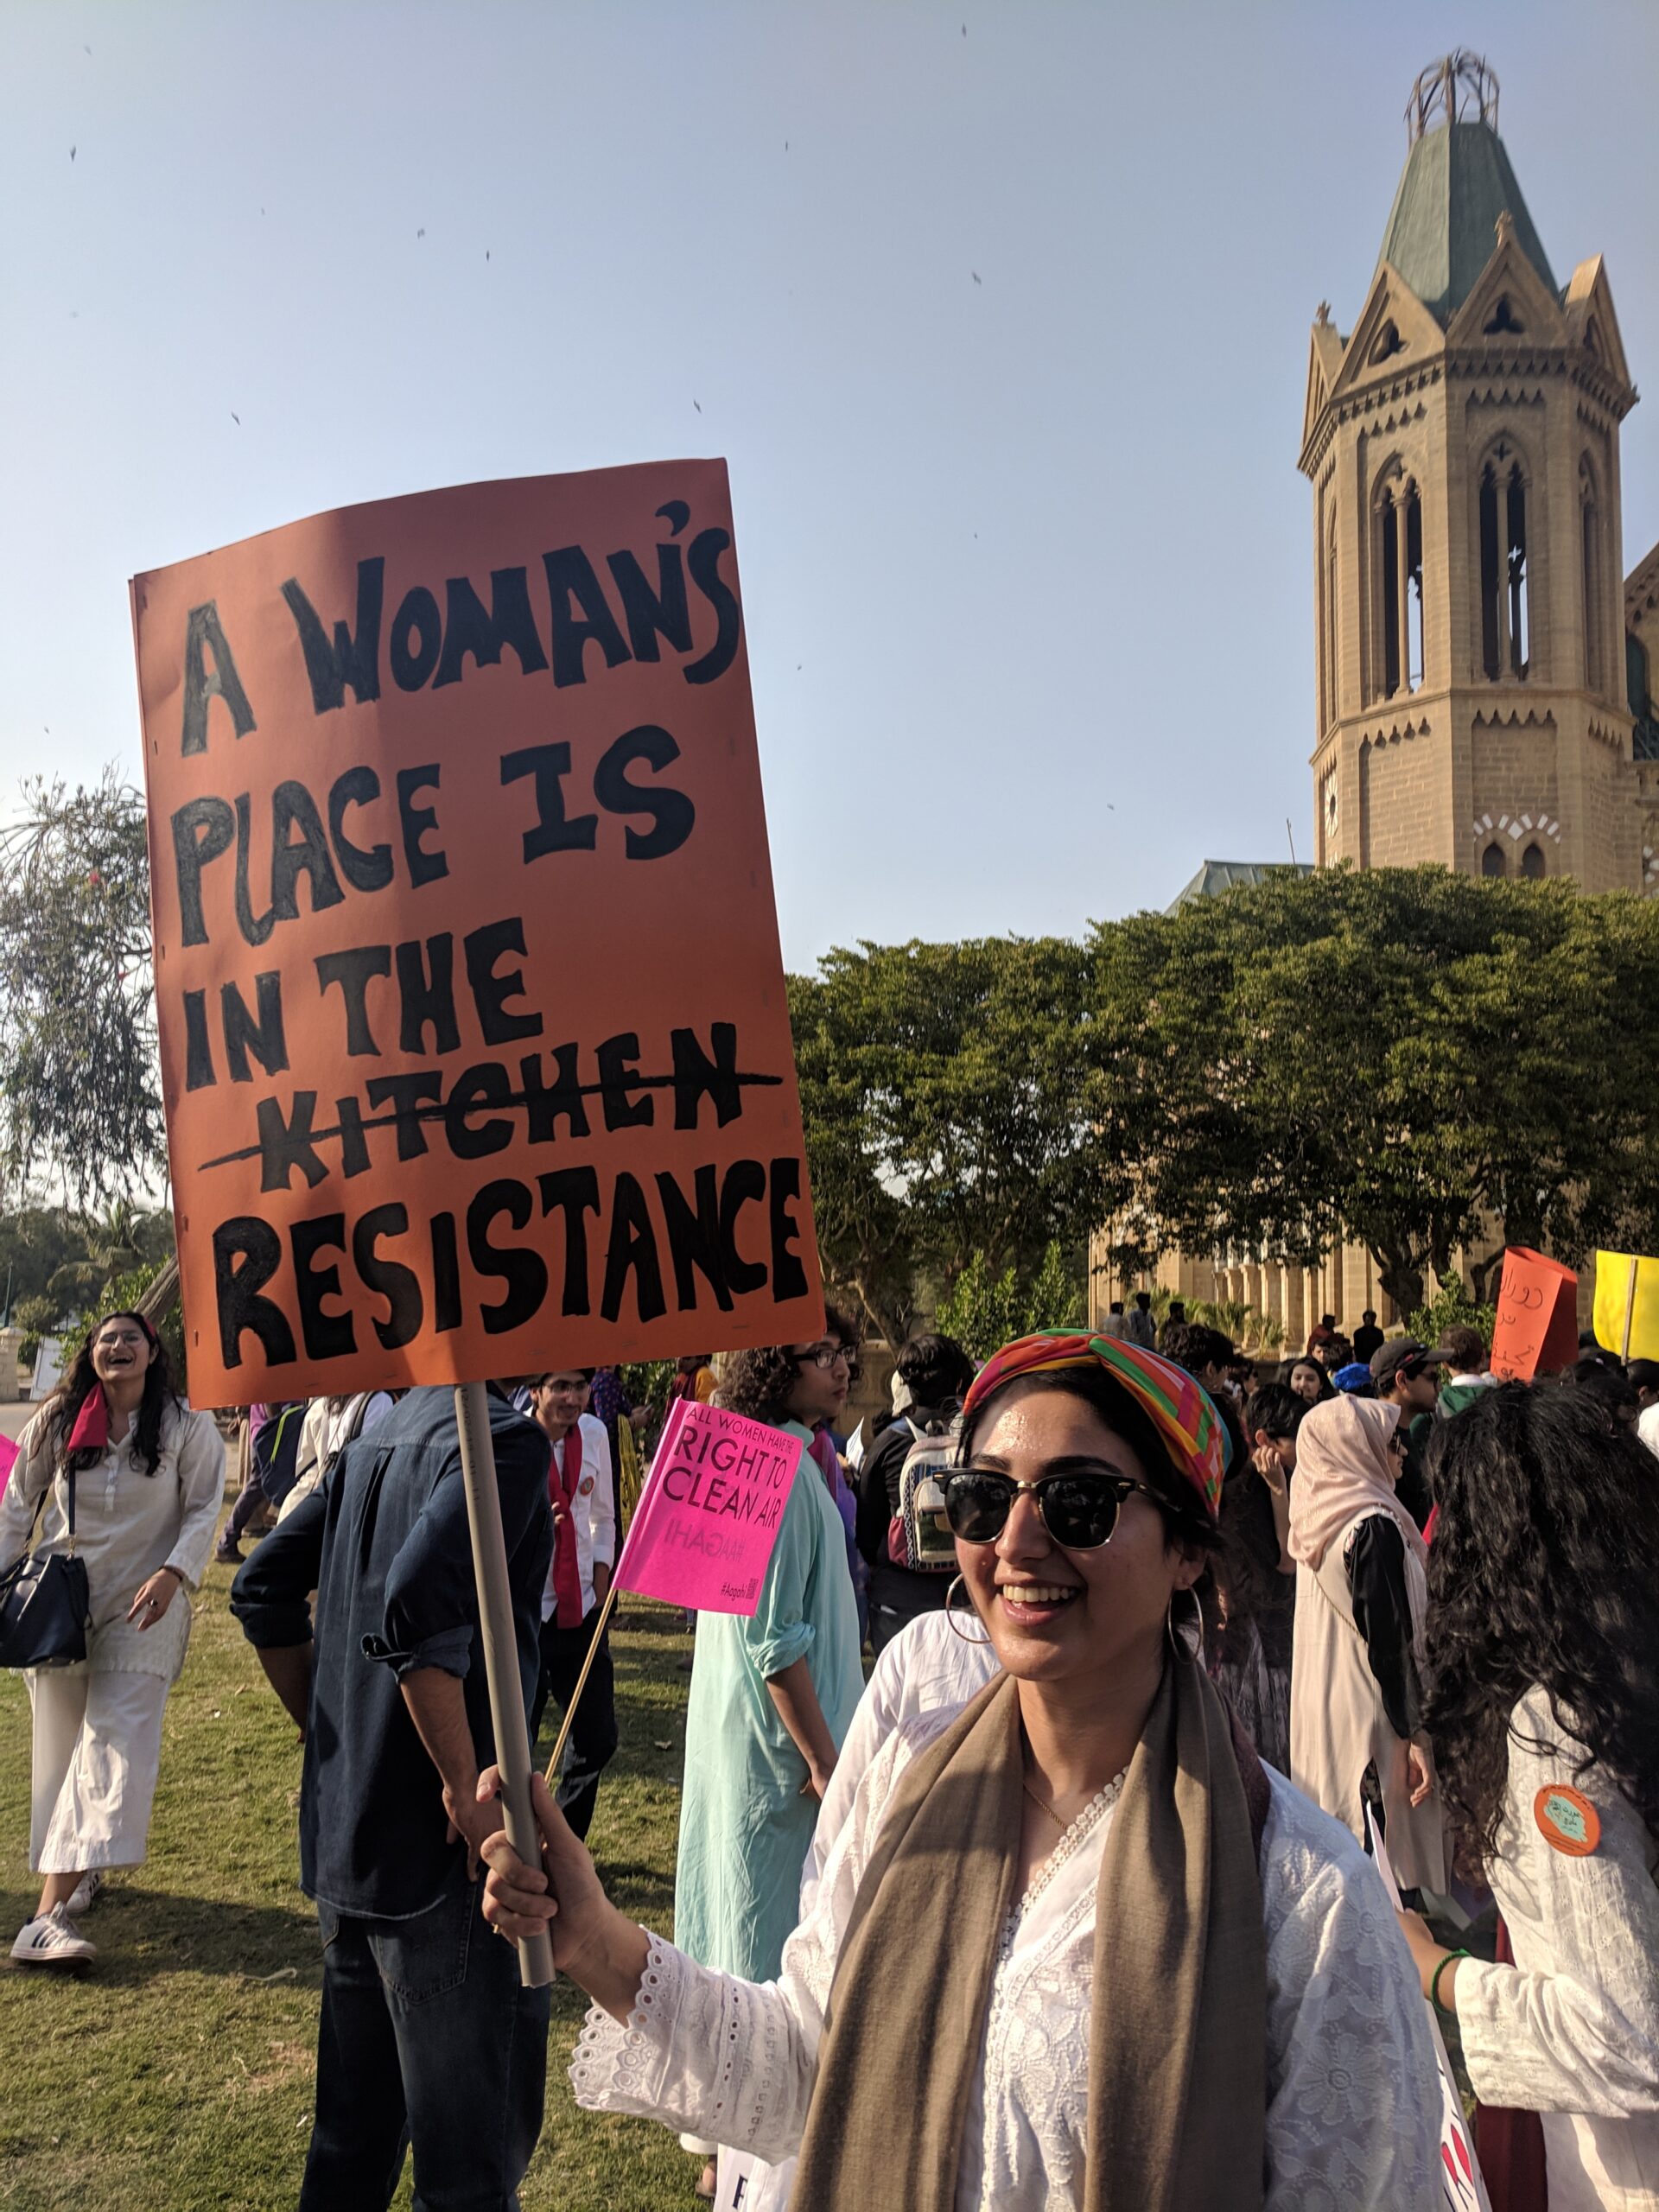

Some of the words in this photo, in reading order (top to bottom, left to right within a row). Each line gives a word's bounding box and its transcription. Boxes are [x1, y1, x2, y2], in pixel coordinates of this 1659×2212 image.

[180, 600, 257, 758] A
[281, 499, 741, 713] WOMAN'S
[170, 762, 449, 948] PLACE
[501, 725, 696, 865] IS
[182, 969, 289, 1092] IN
[315, 918, 545, 1058] THE
[256, 1020, 744, 1192] KITCHEN
[213, 1156, 809, 1369] RESISTANCE
[663, 1466, 759, 1522] CLEAN
[753, 1496, 781, 1529] AIR
[674, 1425, 770, 1483] RIGHT
[766, 1456, 787, 1489] TO
[687, 1408, 712, 1425] ALL
[719, 1414, 767, 1444] WOMEN
[767, 1433, 786, 1452] HAVE
